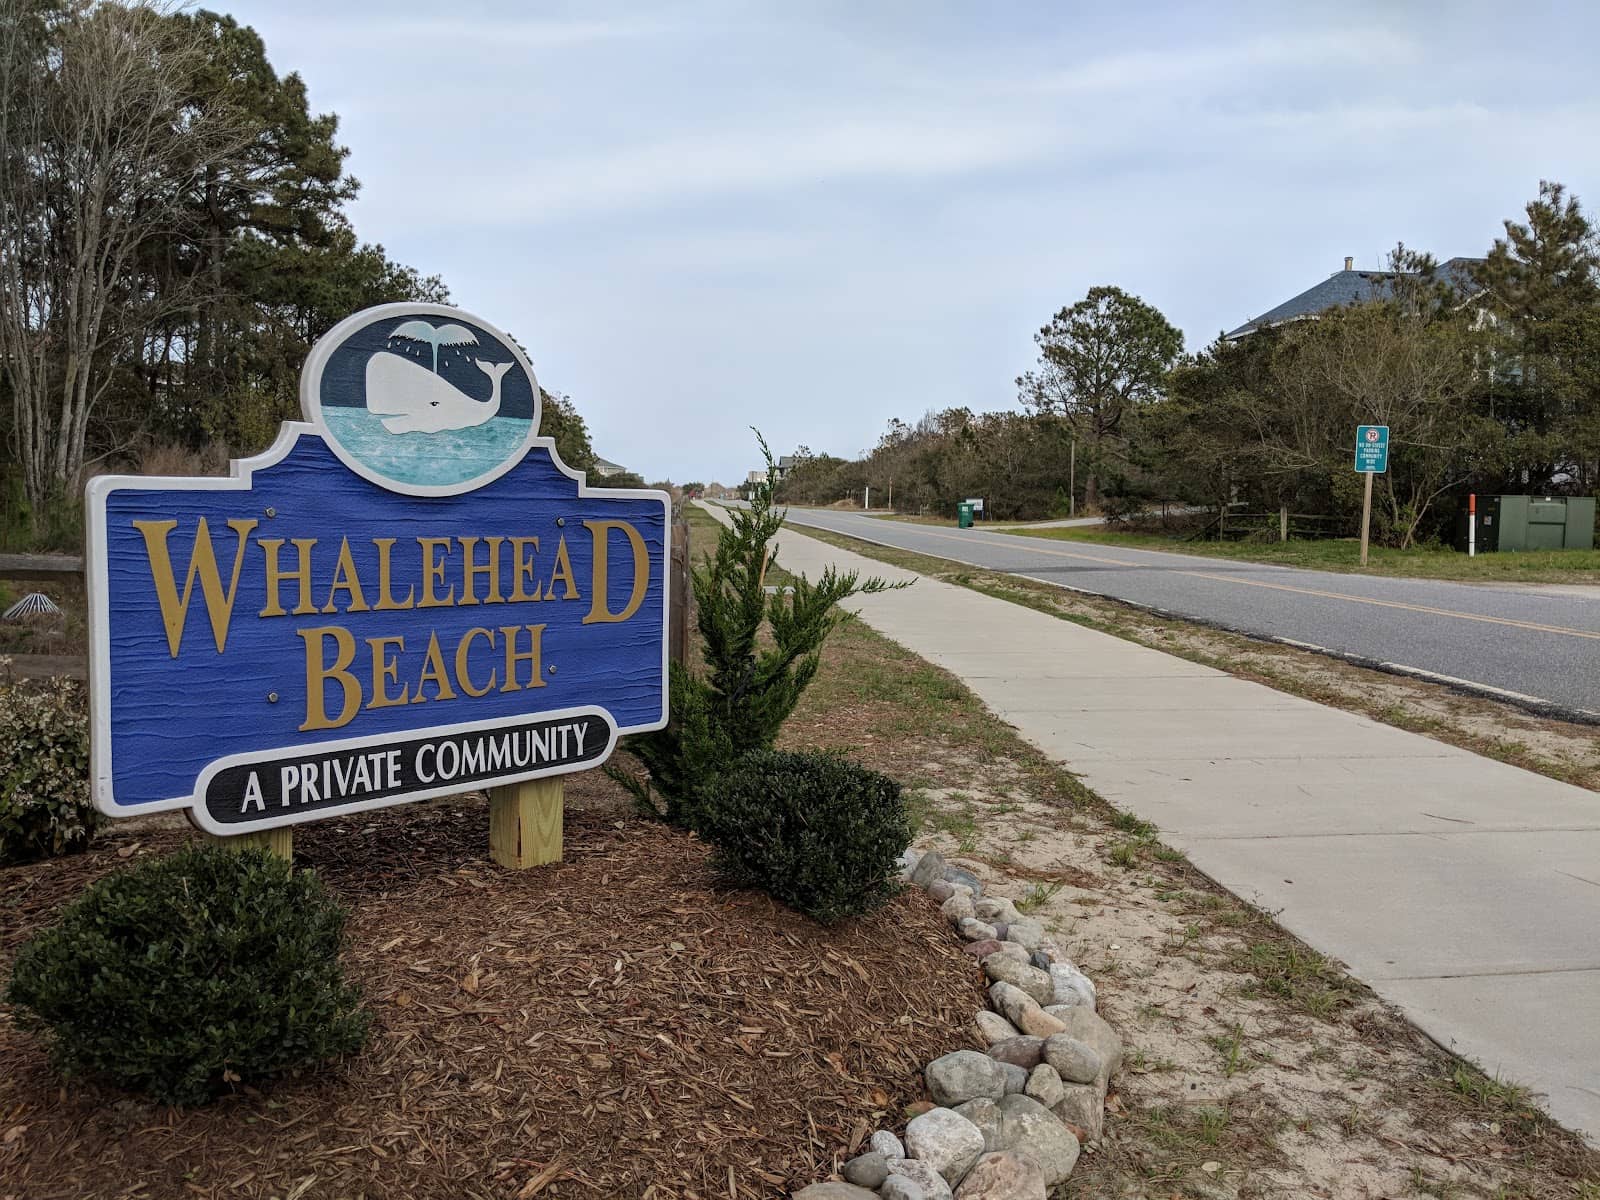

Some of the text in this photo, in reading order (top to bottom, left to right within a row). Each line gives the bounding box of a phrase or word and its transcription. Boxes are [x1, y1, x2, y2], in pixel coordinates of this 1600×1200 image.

[132, 516, 650, 658] WHALEHEAD
[298, 624, 547, 732] BEACH
[240, 721, 590, 813] A PRIVATE COMMUNITY
